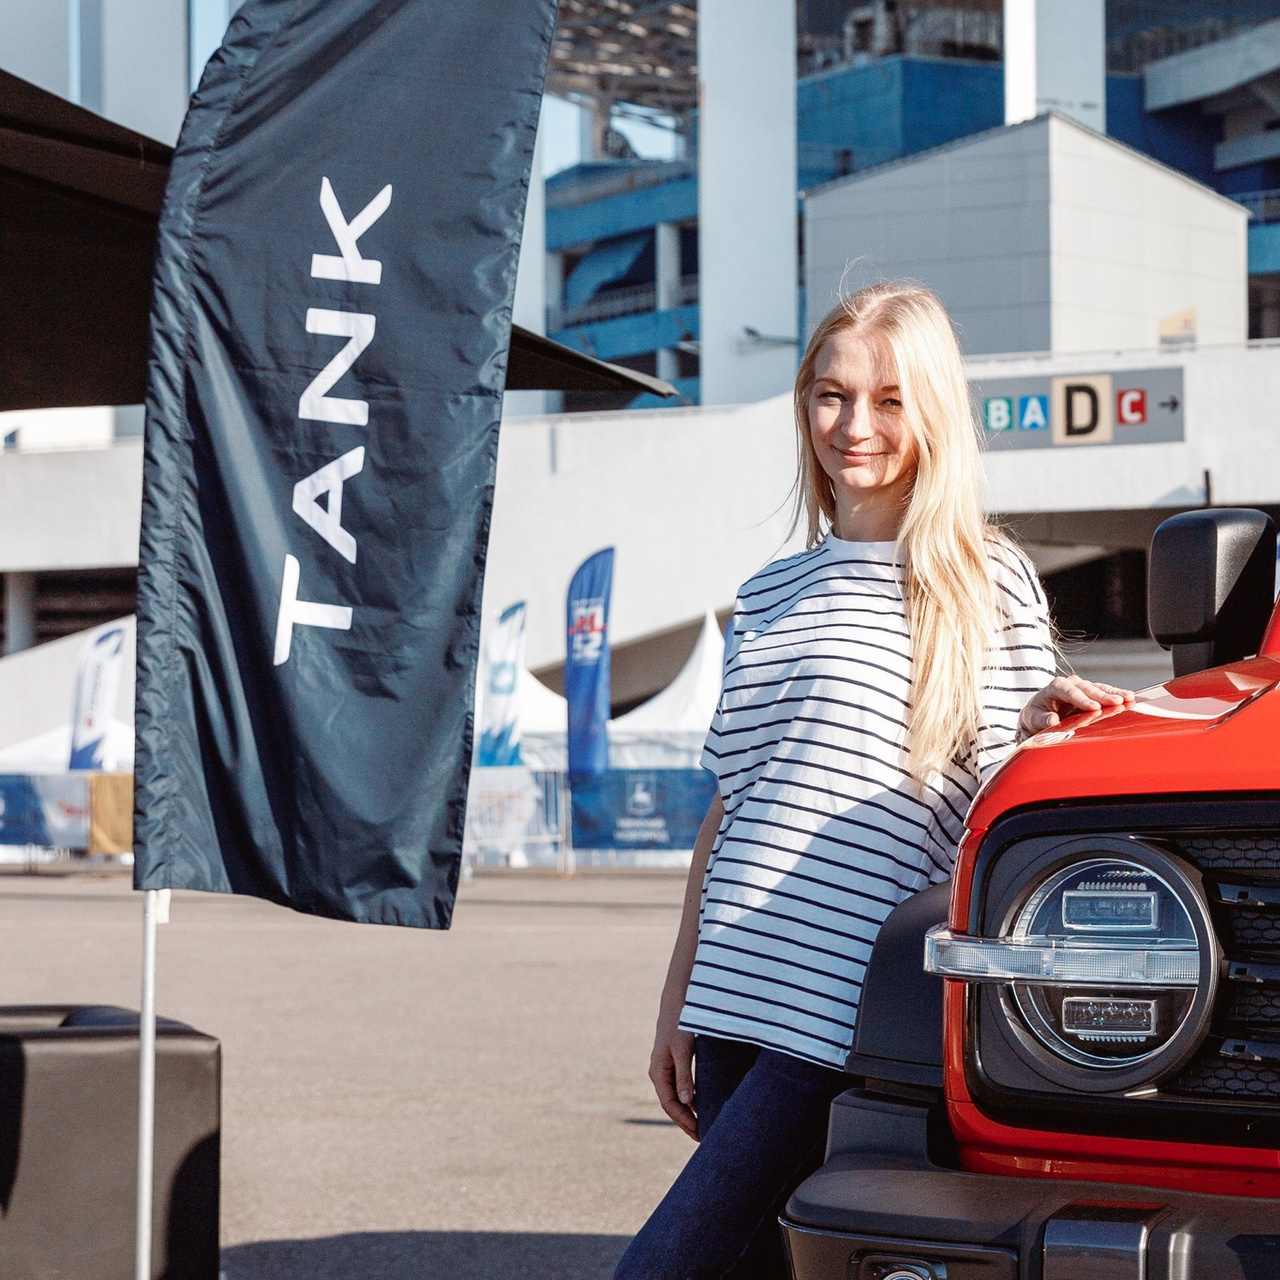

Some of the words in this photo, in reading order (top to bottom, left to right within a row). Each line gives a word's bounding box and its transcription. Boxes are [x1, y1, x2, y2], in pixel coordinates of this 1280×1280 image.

[273, 176, 393, 666] TANK
[987, 397, 1011, 430] B
[1020, 396, 1047, 429] A
[1065, 384, 1099, 437] D
[1120, 390, 1142, 424] C
